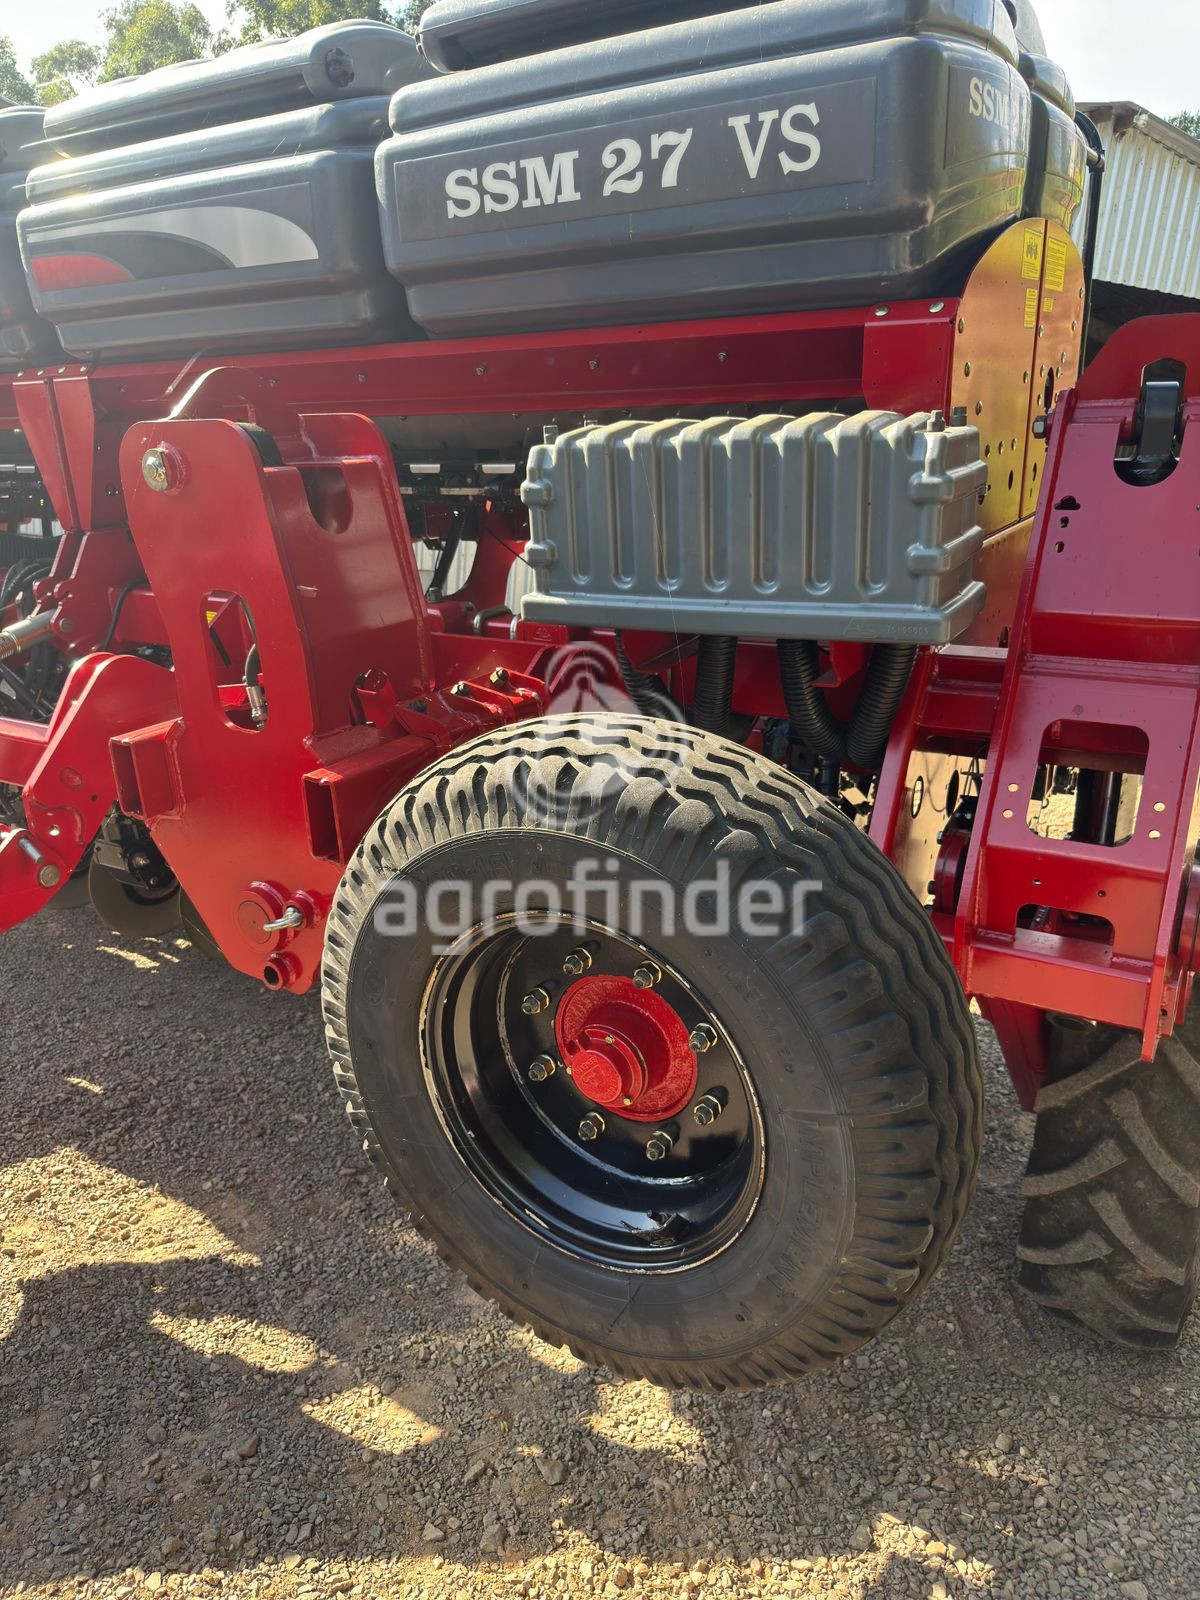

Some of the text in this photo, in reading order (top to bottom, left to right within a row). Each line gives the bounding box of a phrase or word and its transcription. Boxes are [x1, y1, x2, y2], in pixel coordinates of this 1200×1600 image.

[968, 76, 1010, 130] SSM
[444, 102, 821, 219] SSM 27 VS
